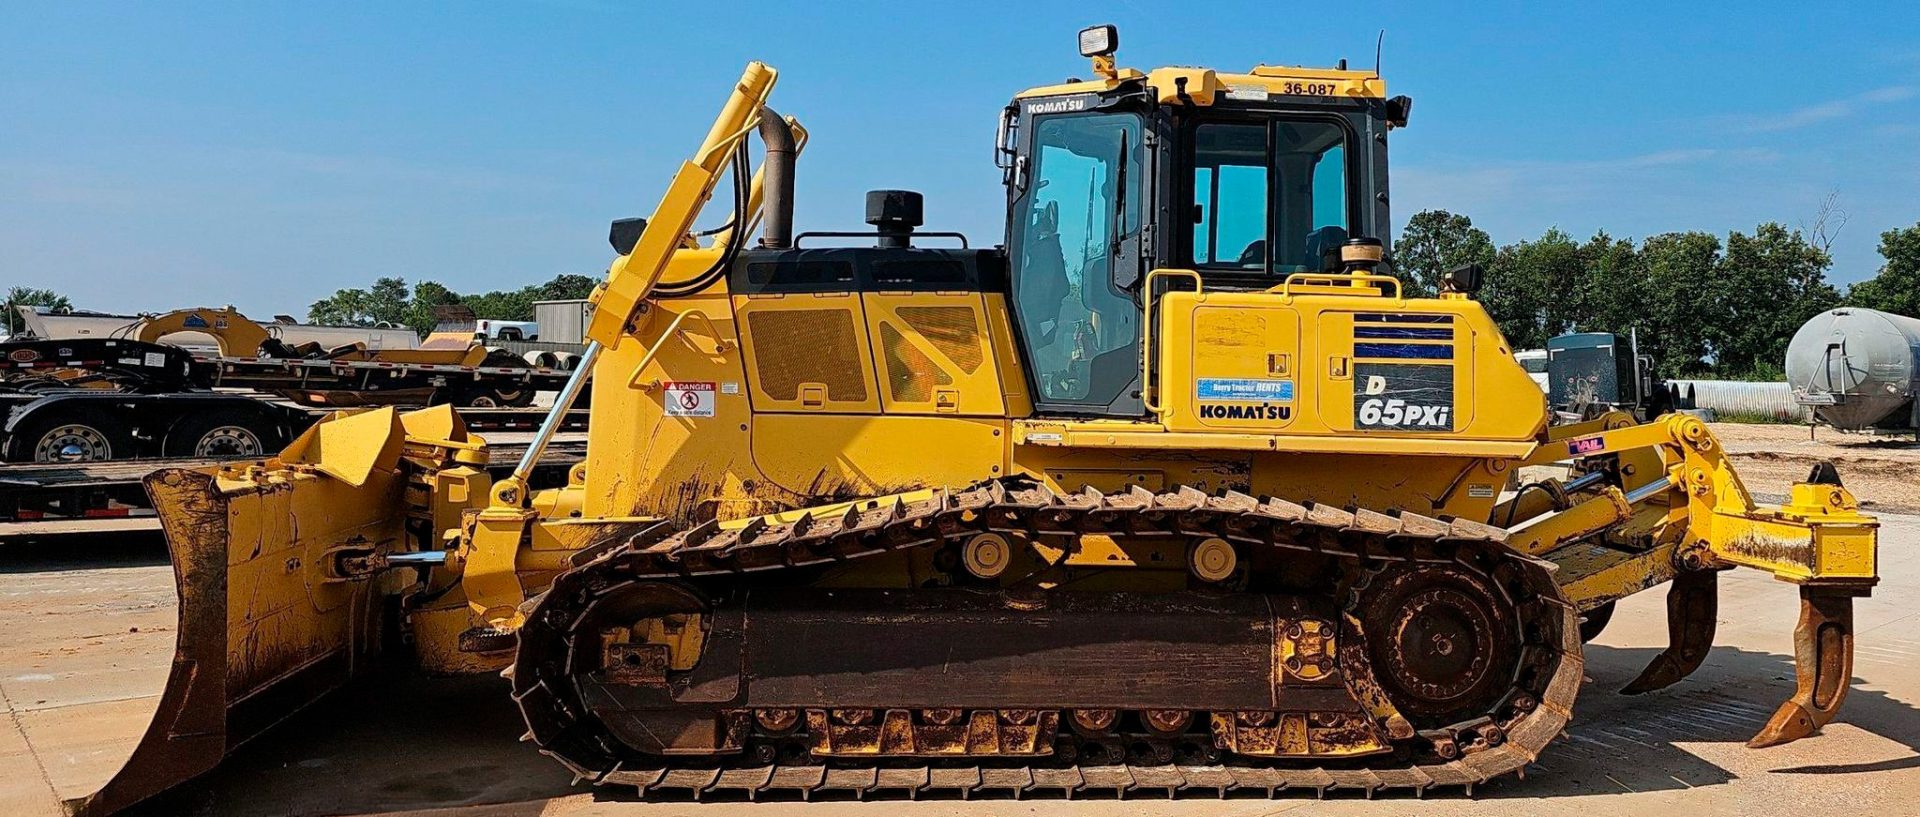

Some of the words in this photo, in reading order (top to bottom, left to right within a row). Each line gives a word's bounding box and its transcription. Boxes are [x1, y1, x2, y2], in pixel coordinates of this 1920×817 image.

[1283, 82, 1336, 96] 36-087
[1027, 98, 1084, 114] KOMATSU
[1256, 382, 1281, 392] RENTS
[1365, 375, 1386, 395] D
[1200, 402, 1291, 420] KOMATSU
[1359, 399, 1449, 426] 65PXi
[1576, 438, 1603, 452] VAIL
